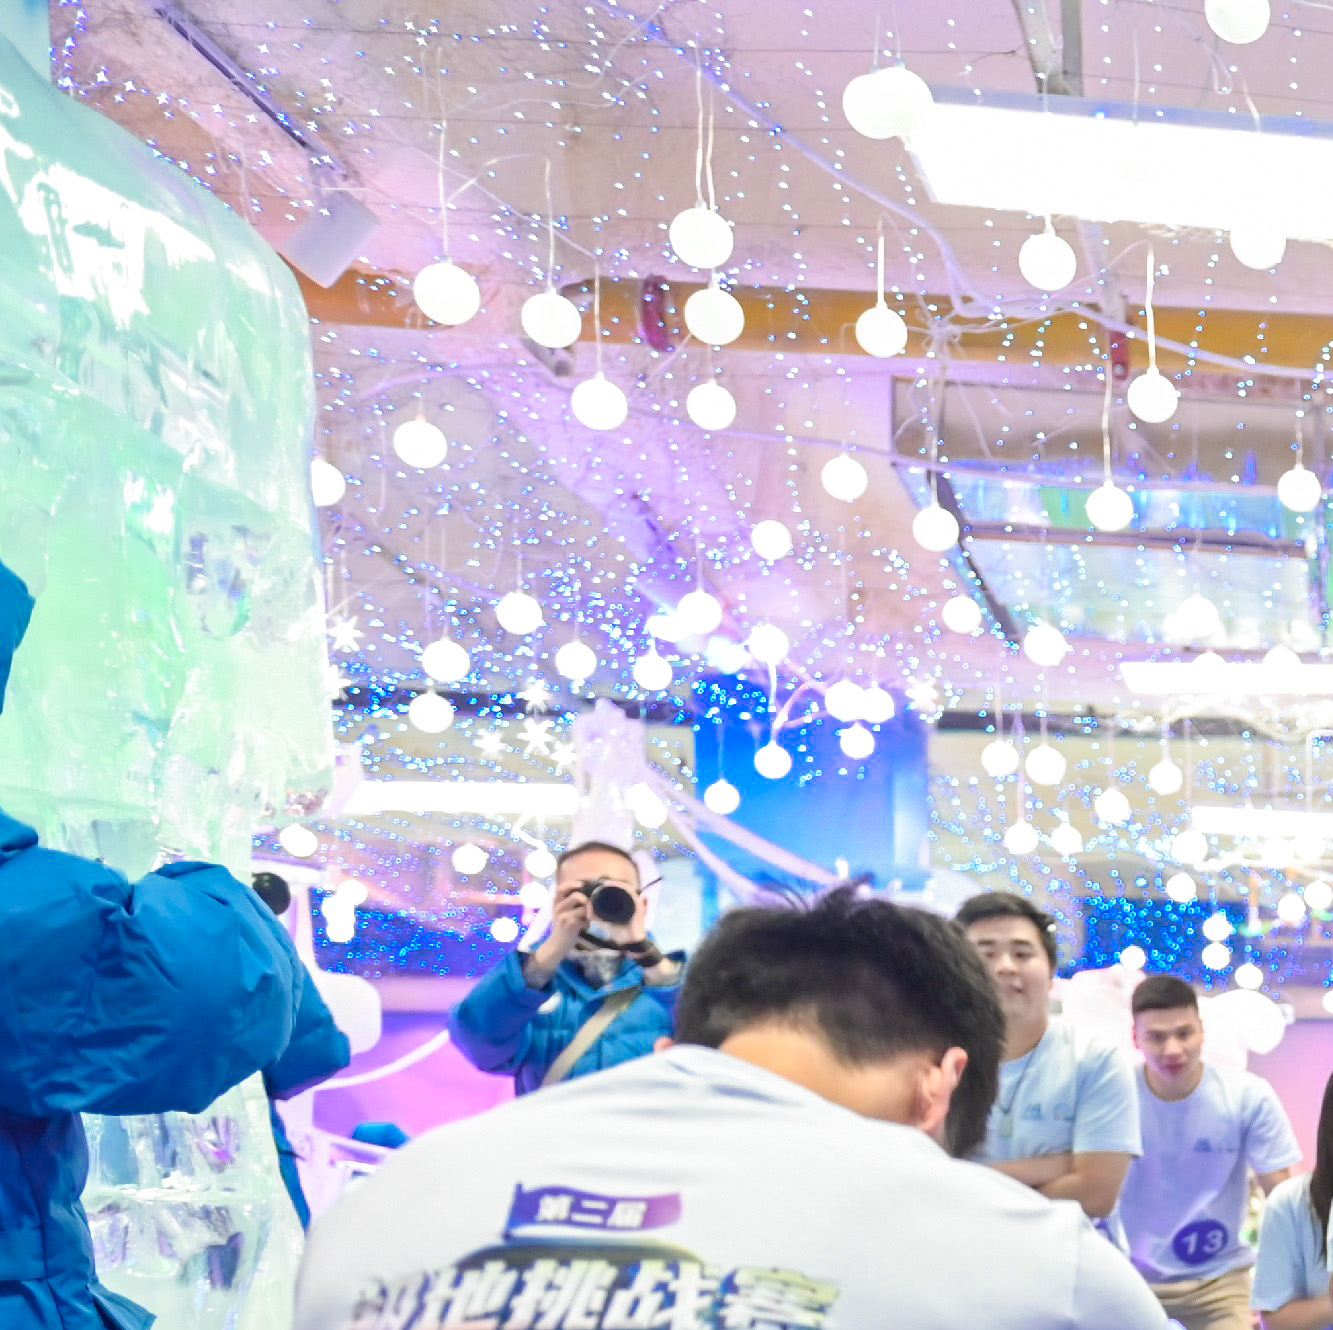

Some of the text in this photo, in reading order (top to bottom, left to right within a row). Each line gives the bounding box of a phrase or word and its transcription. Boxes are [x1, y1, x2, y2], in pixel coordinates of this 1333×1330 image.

[534, 1194, 648, 1228] 第二届
[1181, 1229, 1224, 1256] 13
